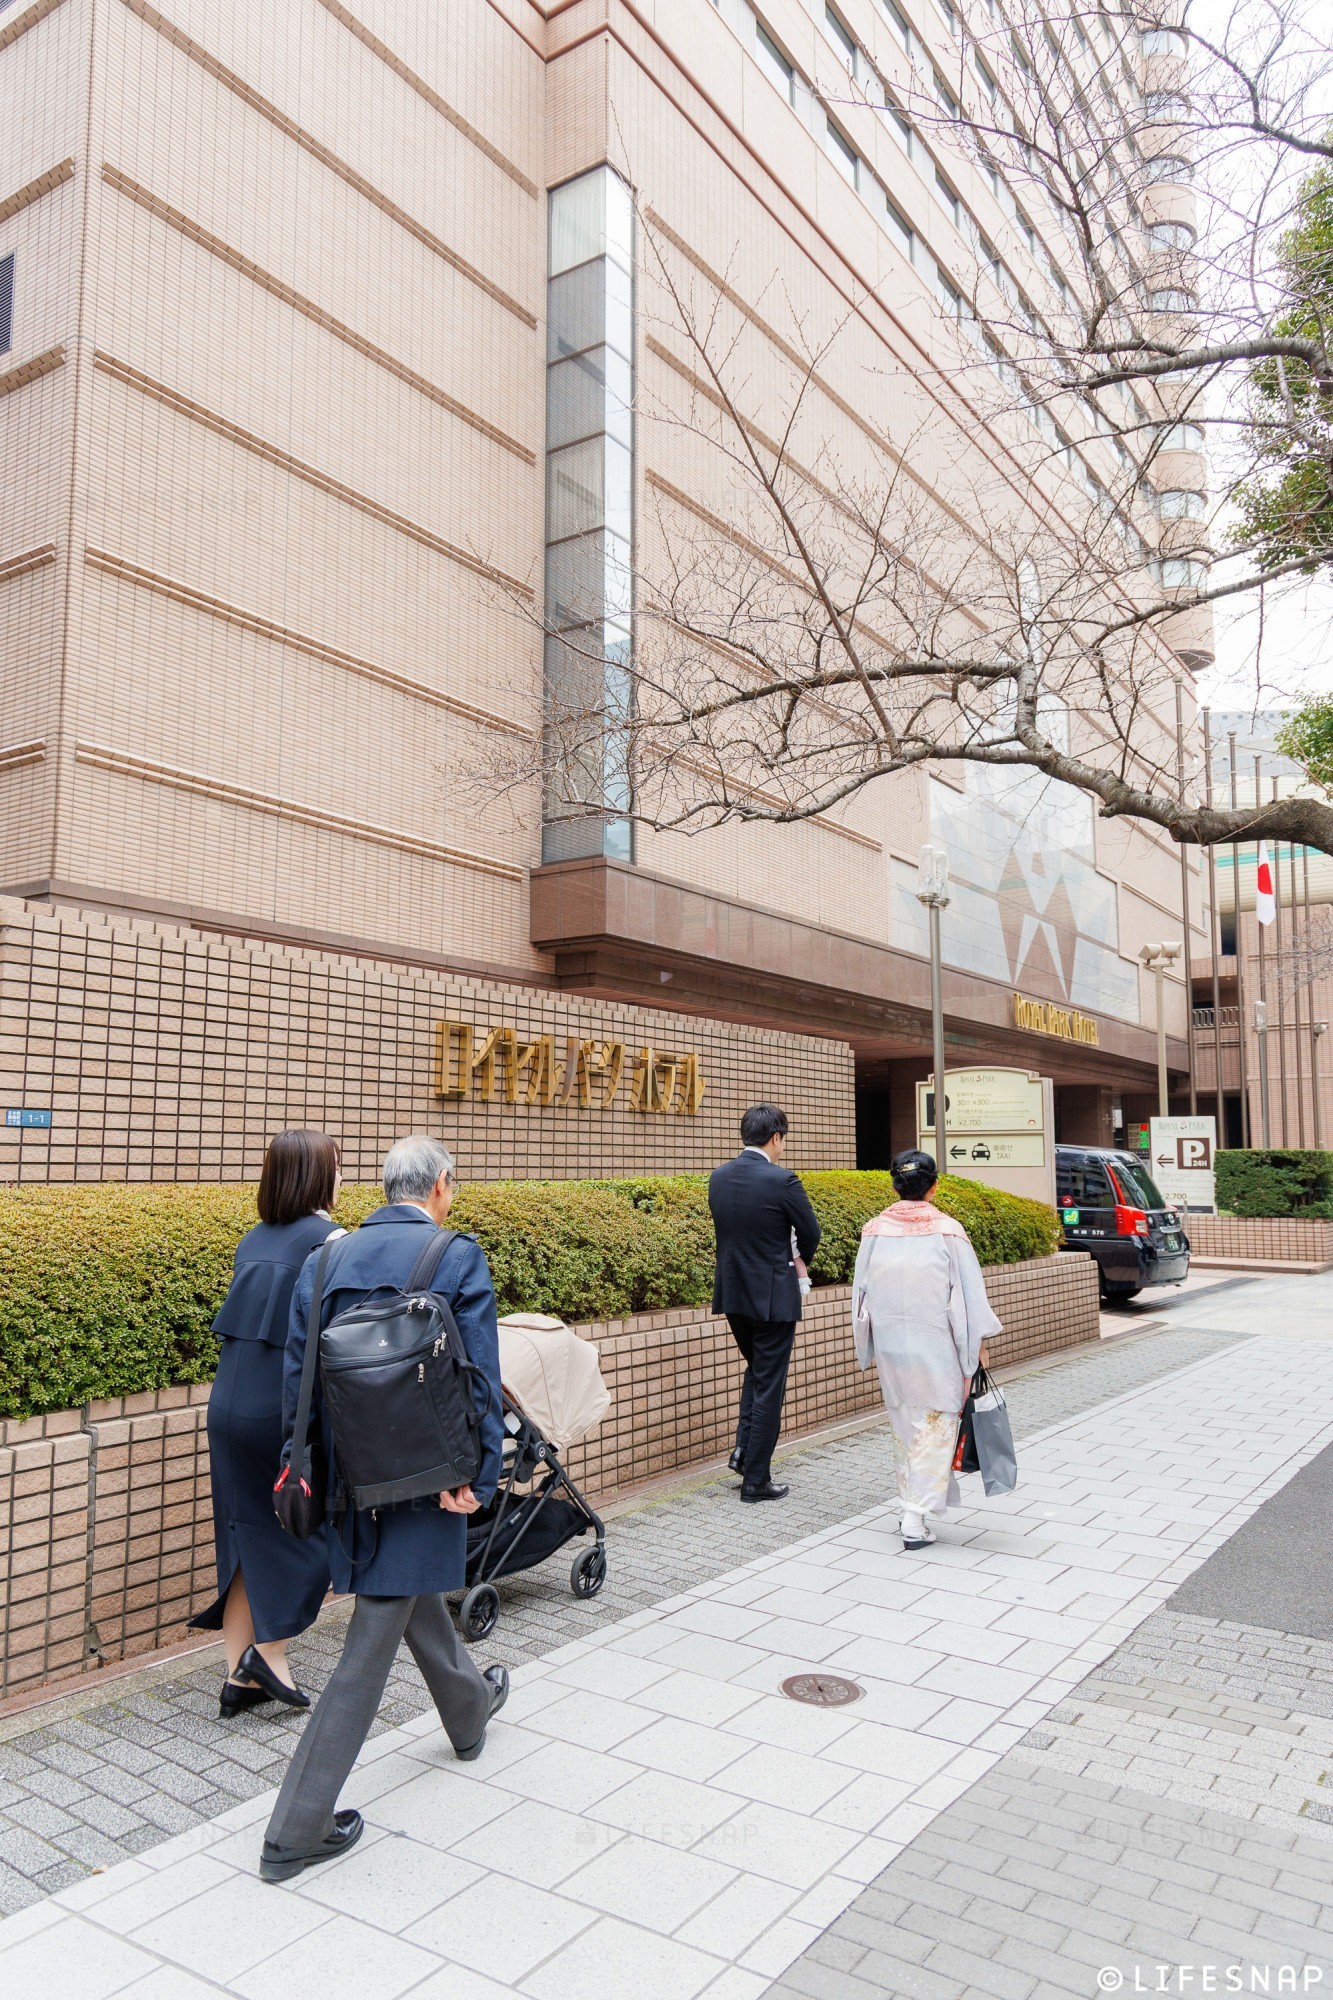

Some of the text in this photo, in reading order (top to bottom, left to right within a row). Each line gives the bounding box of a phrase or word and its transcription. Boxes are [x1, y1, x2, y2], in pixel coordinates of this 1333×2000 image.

[1014, 991, 1046, 1031] ROYAL
[1045, 1002, 1073, 1039] PARK
[434, 1022, 708, 1115] ロイヤルパークホテル
[28, 1114, 45, 1123] 1-1
[1158, 1119, 1207, 1130] ROYAL PARK
[1182, 1140, 1205, 1167] P
